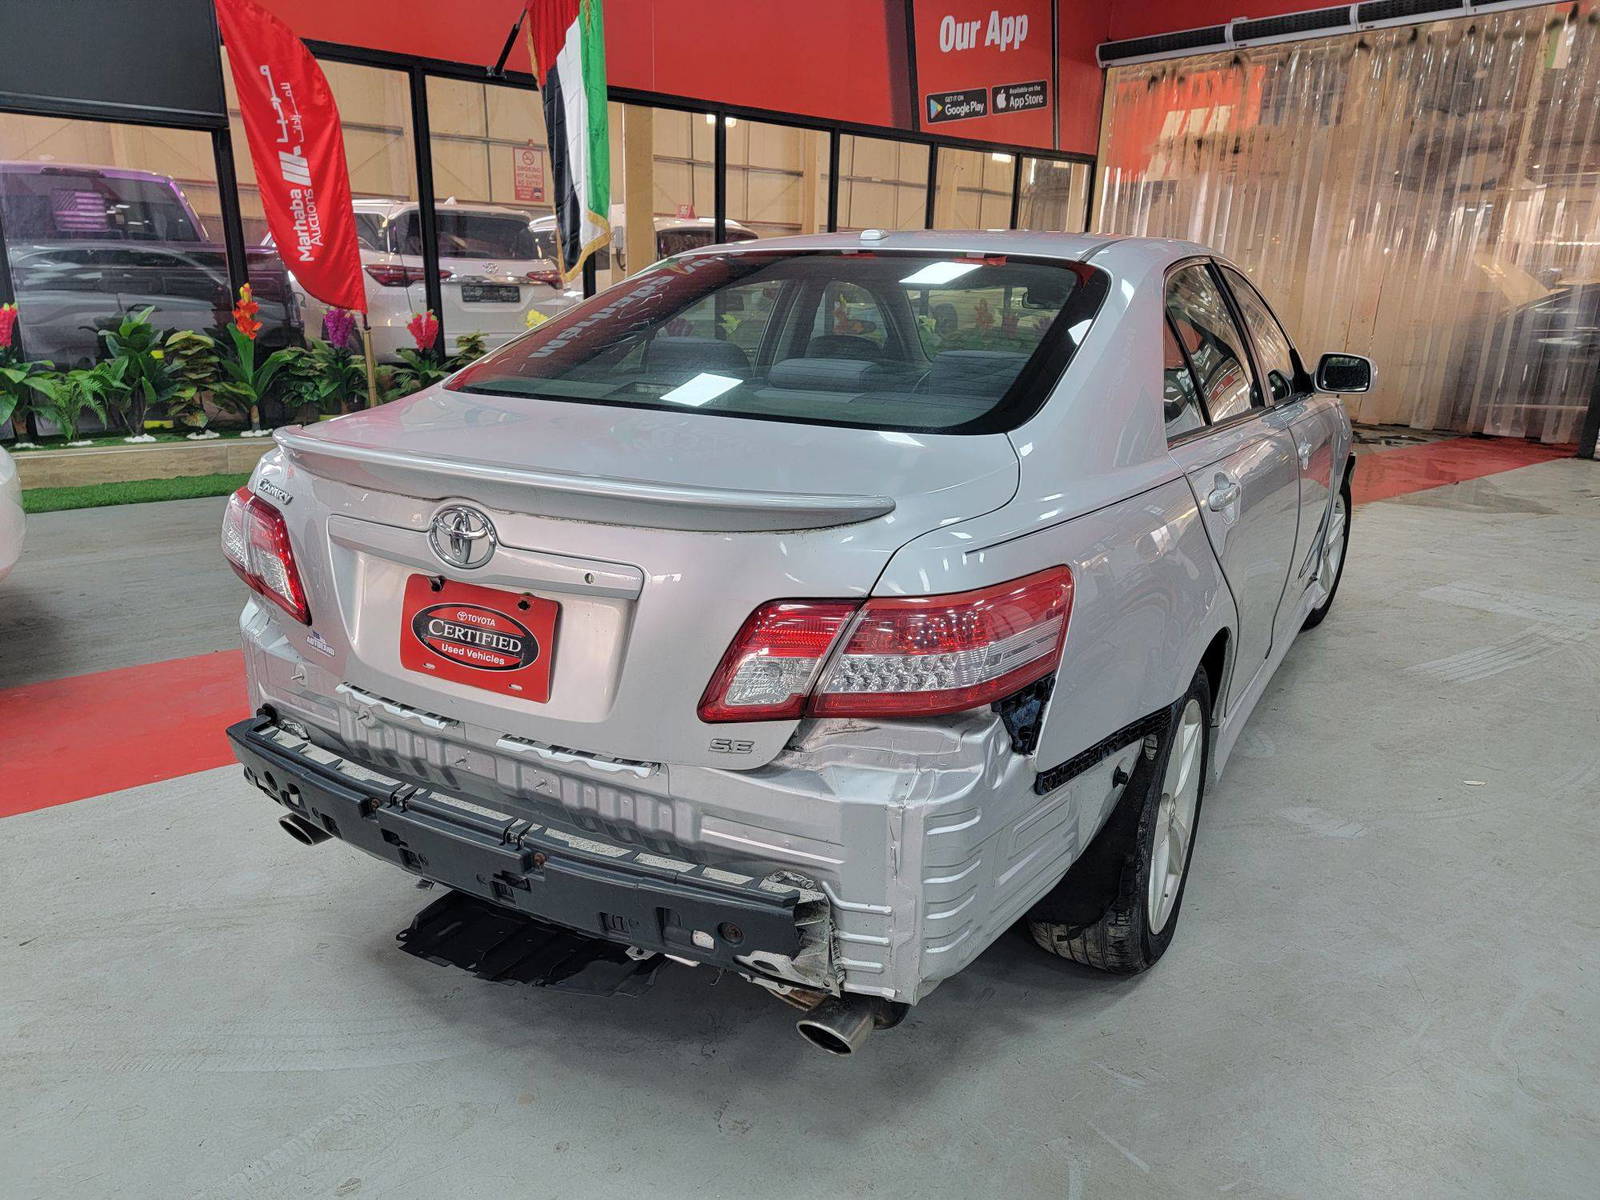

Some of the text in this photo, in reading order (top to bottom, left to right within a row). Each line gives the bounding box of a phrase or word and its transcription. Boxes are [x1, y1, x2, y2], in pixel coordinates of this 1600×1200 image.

[939, 10, 1029, 53] Our App
[945, 101, 984, 116] Google Play
[1009, 94, 1044, 109] App Store
[289, 188, 315, 262] Marhaba
[304, 188, 324, 247] Auctions
[258, 478, 294, 505] CAMRY
[467, 614, 496, 627] TOYOTA
[428, 619, 522, 652] CERTIFIED
[441, 643, 505, 665] Used Vehicles
[708, 738, 755, 754] SE
